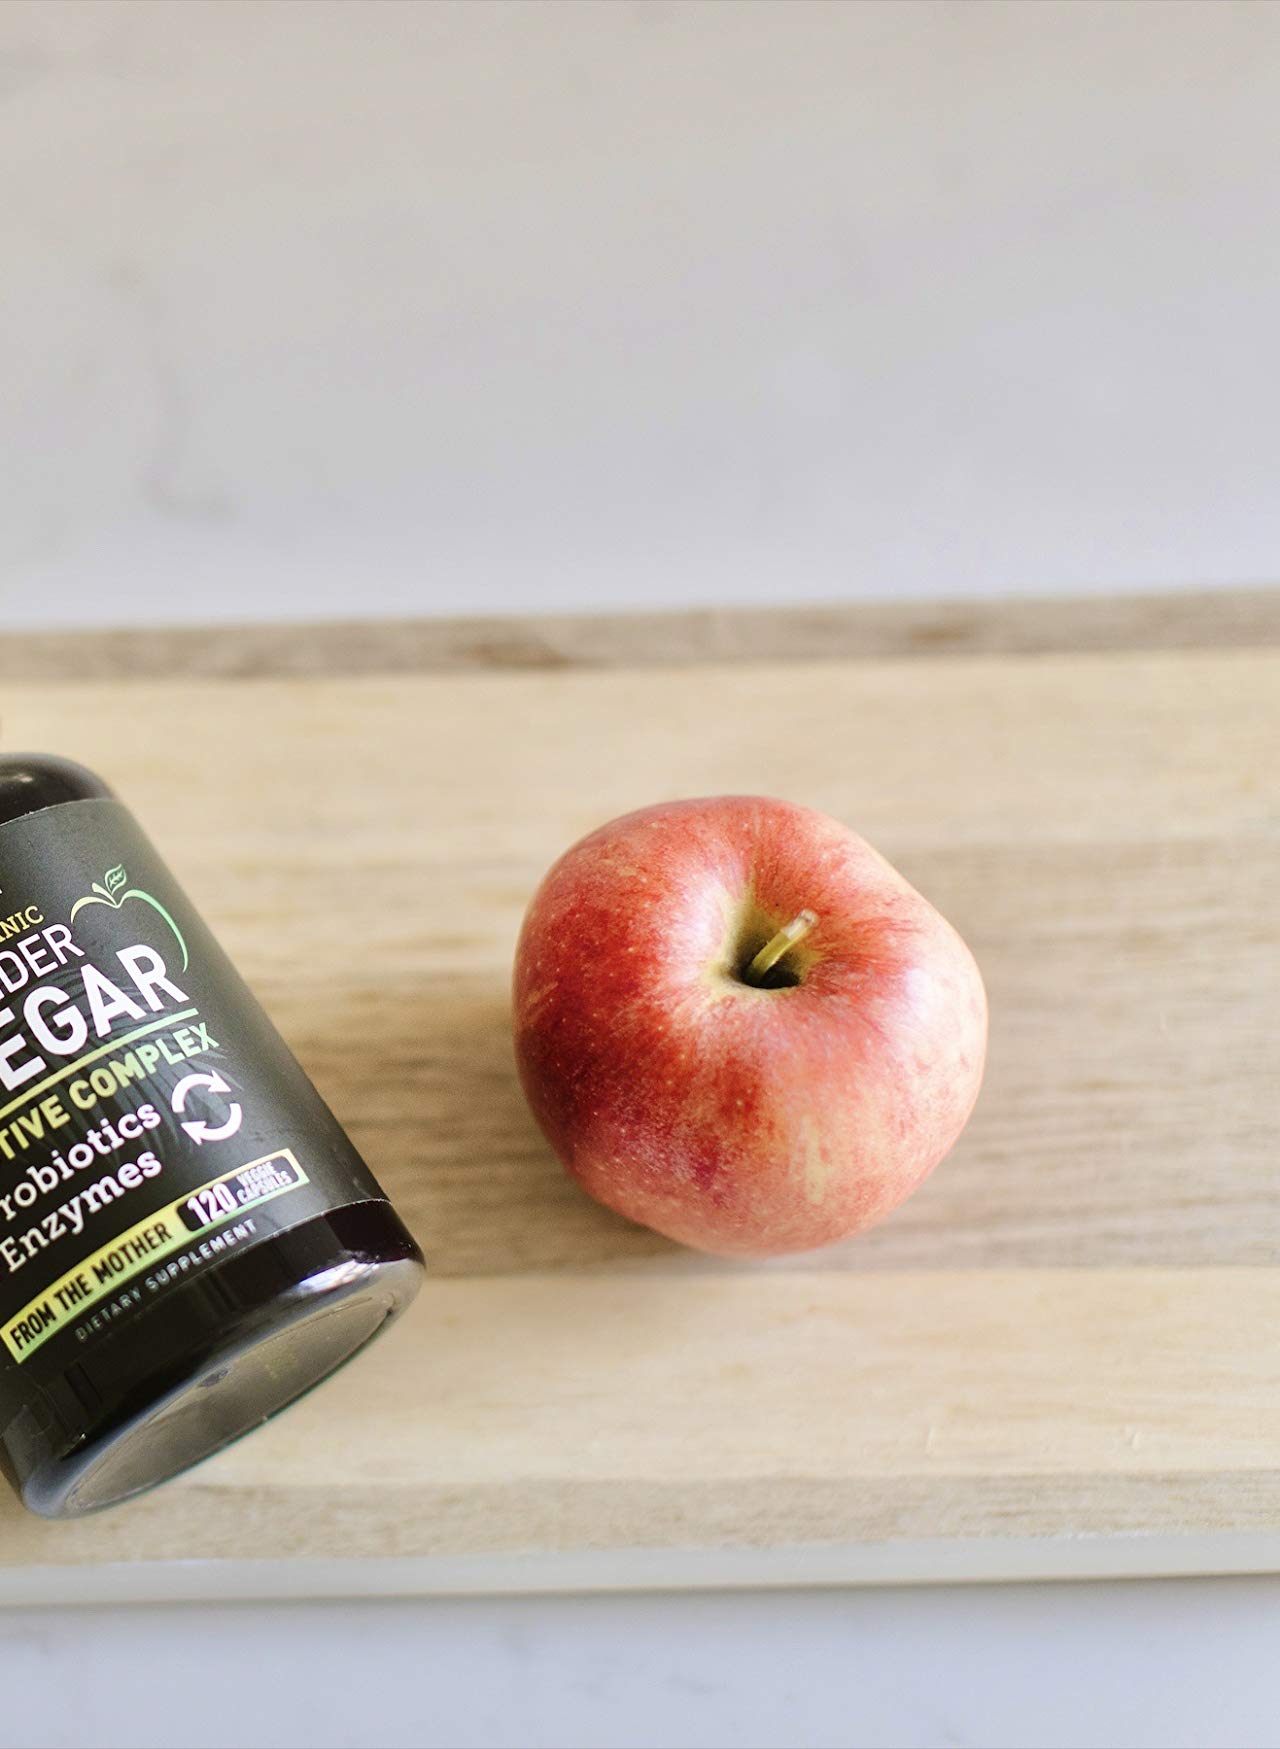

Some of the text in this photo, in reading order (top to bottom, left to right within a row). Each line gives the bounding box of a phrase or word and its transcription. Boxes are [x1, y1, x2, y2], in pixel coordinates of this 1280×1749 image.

[68, 1022, 219, 1110] COMPLEX
[186, 1182, 235, 1228] 120
[235, 1161, 275, 1188] VEGGIE
[236, 1170, 293, 1203] CAPSULES
[9, 1221, 173, 1351] FROM THE MOTHER
[75, 1219, 257, 1342] DIETARY SUPPLEMENT
